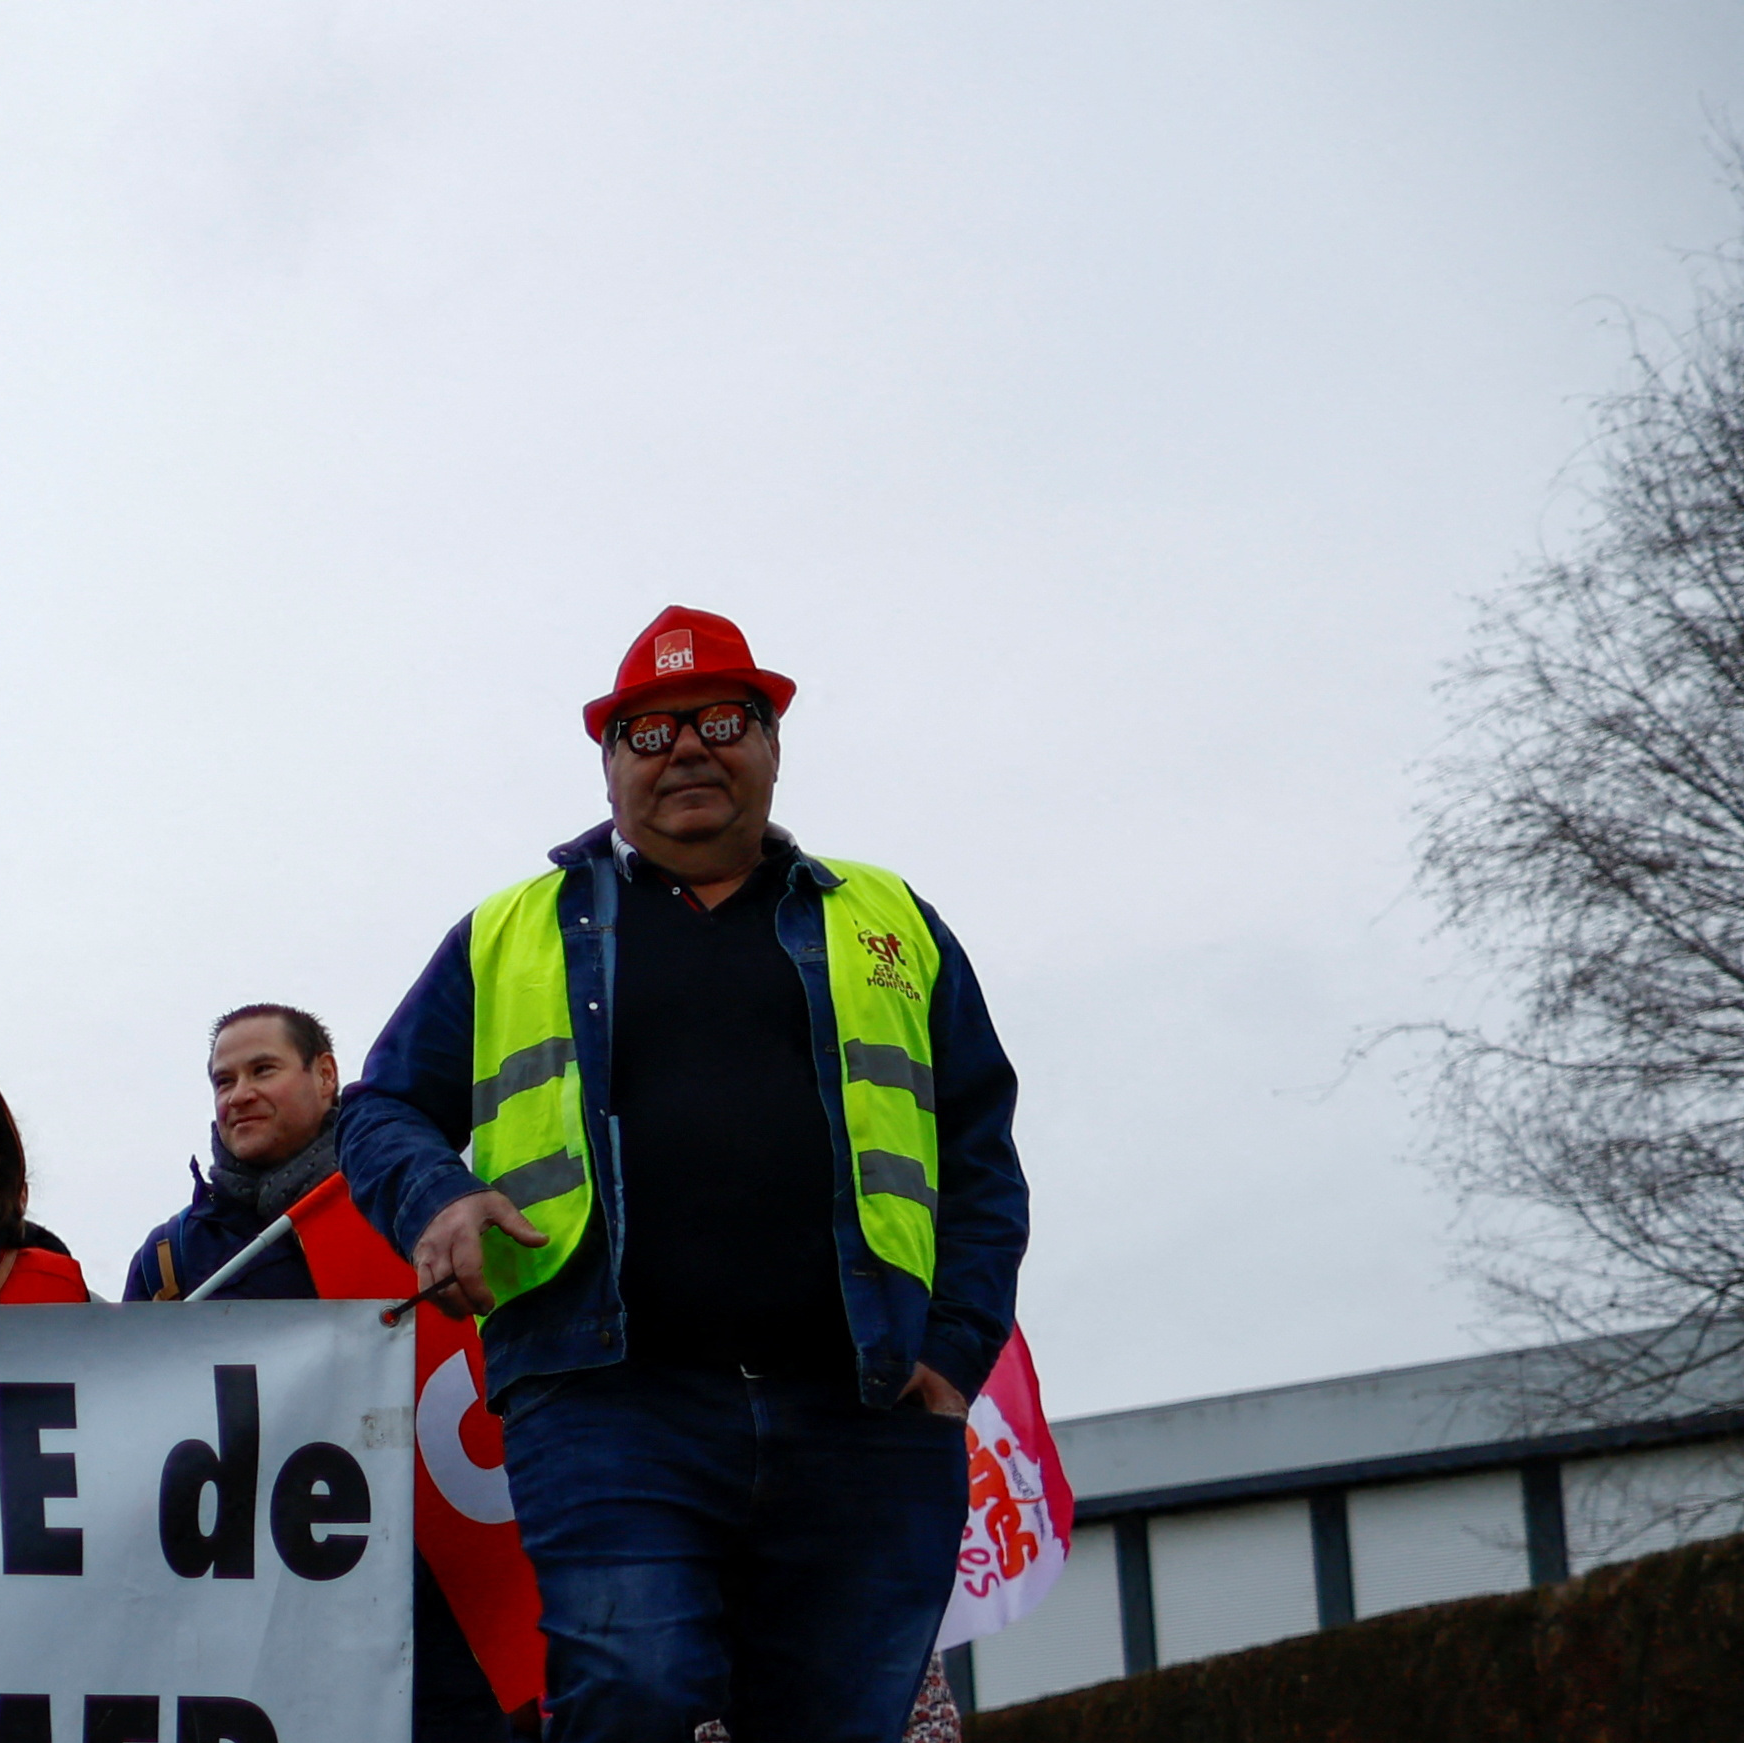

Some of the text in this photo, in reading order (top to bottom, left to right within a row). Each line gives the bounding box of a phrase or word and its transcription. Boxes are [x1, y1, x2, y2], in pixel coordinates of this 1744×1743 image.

[656, 647, 694, 669] cgt
[630, 723, 672, 751] cgt
[700, 713, 741, 741] cgt
[158, 1364, 371, 1581] de
